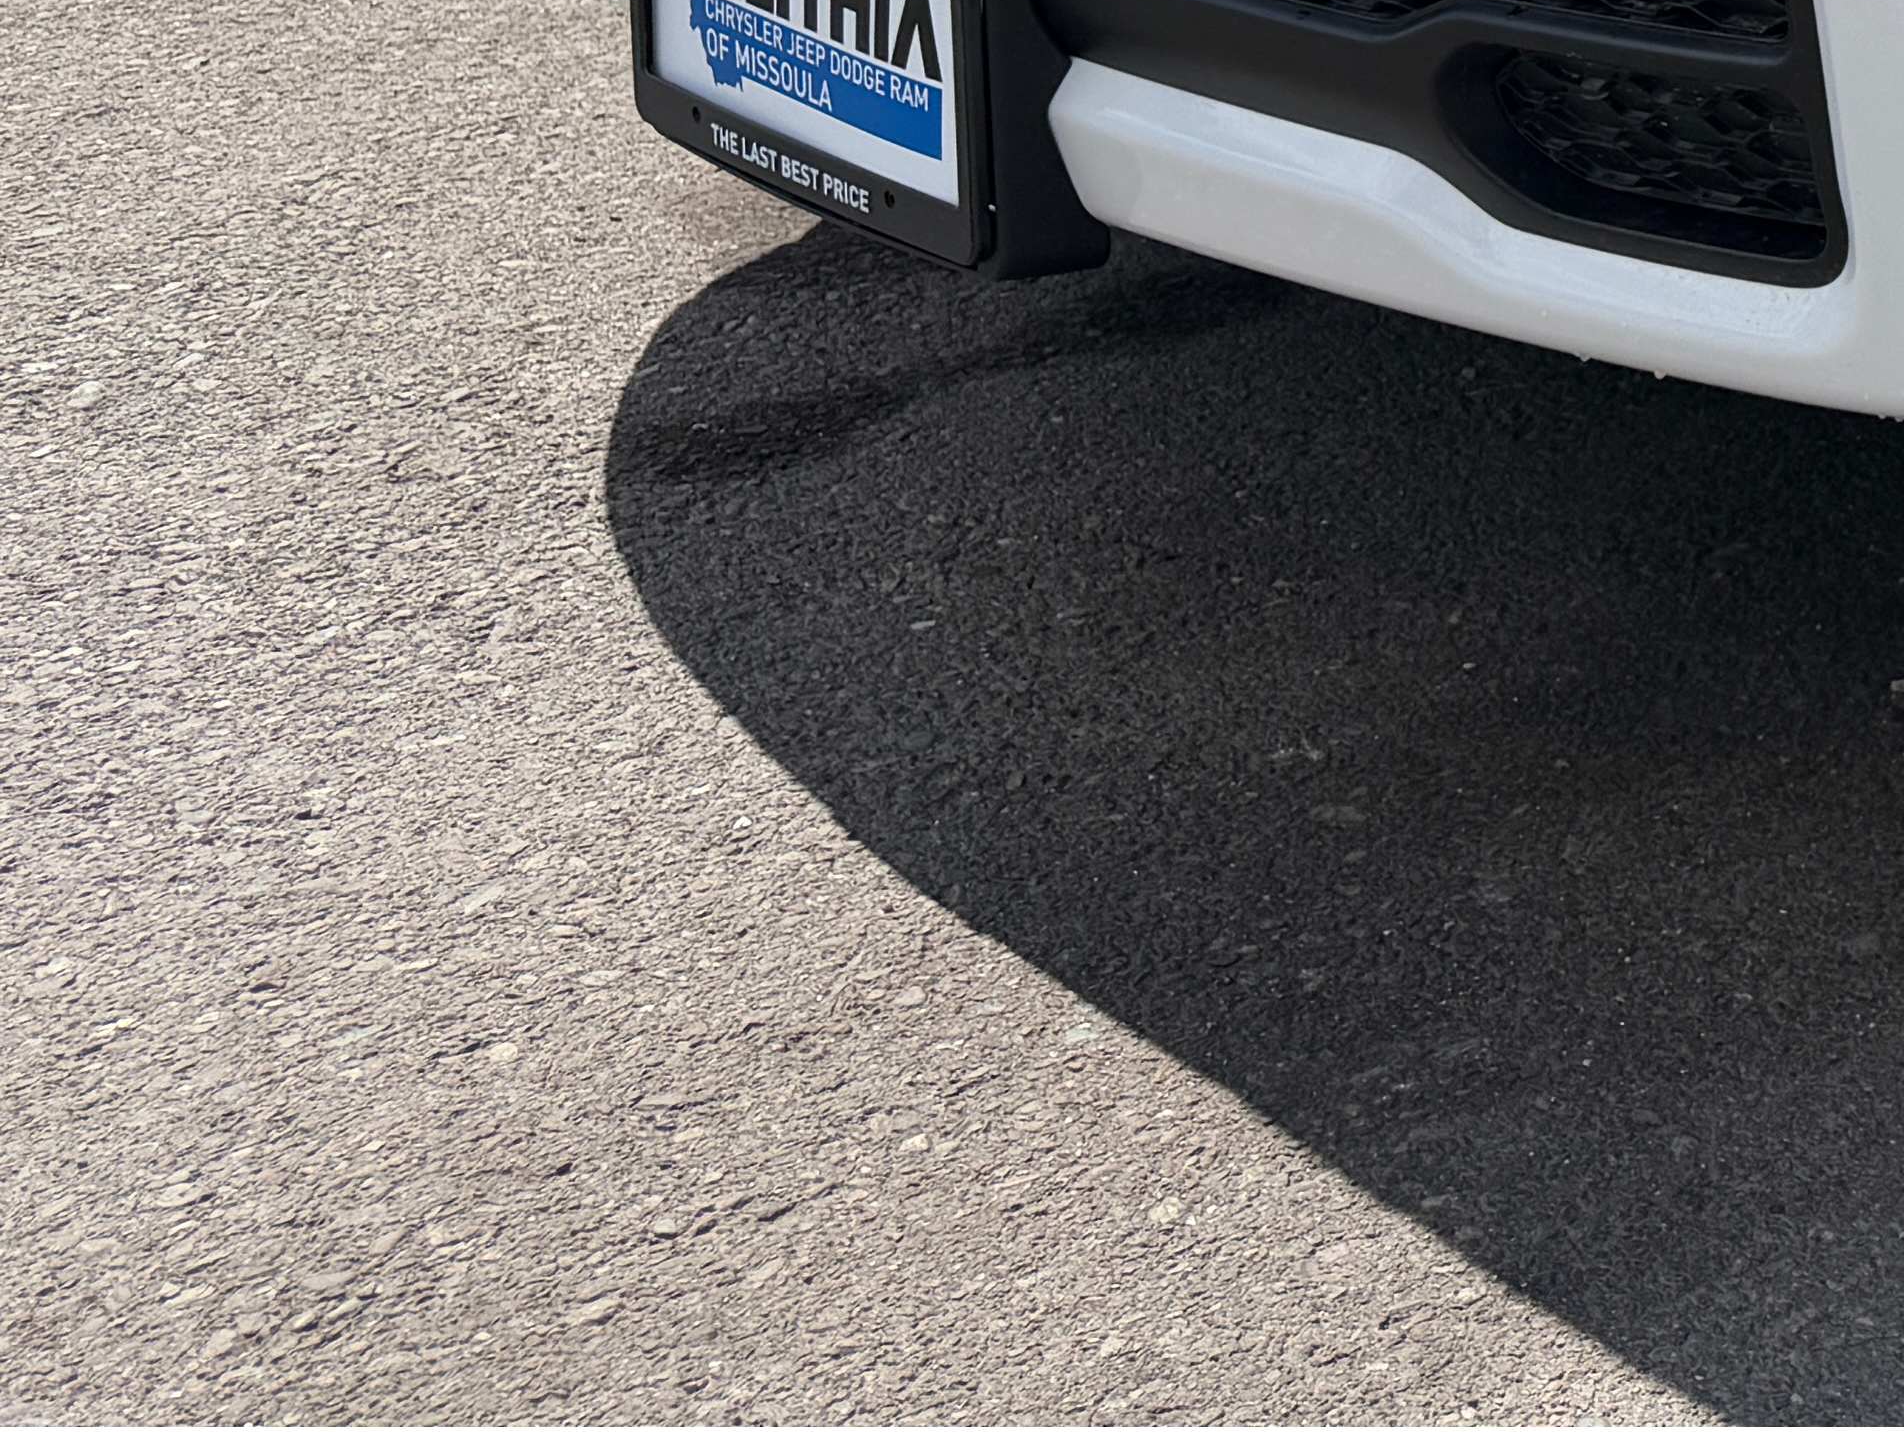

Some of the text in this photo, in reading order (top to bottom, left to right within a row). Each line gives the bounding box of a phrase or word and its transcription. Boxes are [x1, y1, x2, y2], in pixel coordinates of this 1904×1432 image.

[705, 28, 833, 113] OF MISSOULA
[787, 32, 826, 67] JEEP
[830, 49, 886, 97] DODGE
[890, 75, 929, 113] RAM
[710, 122, 870, 214] THE LAST BEST PRICE
